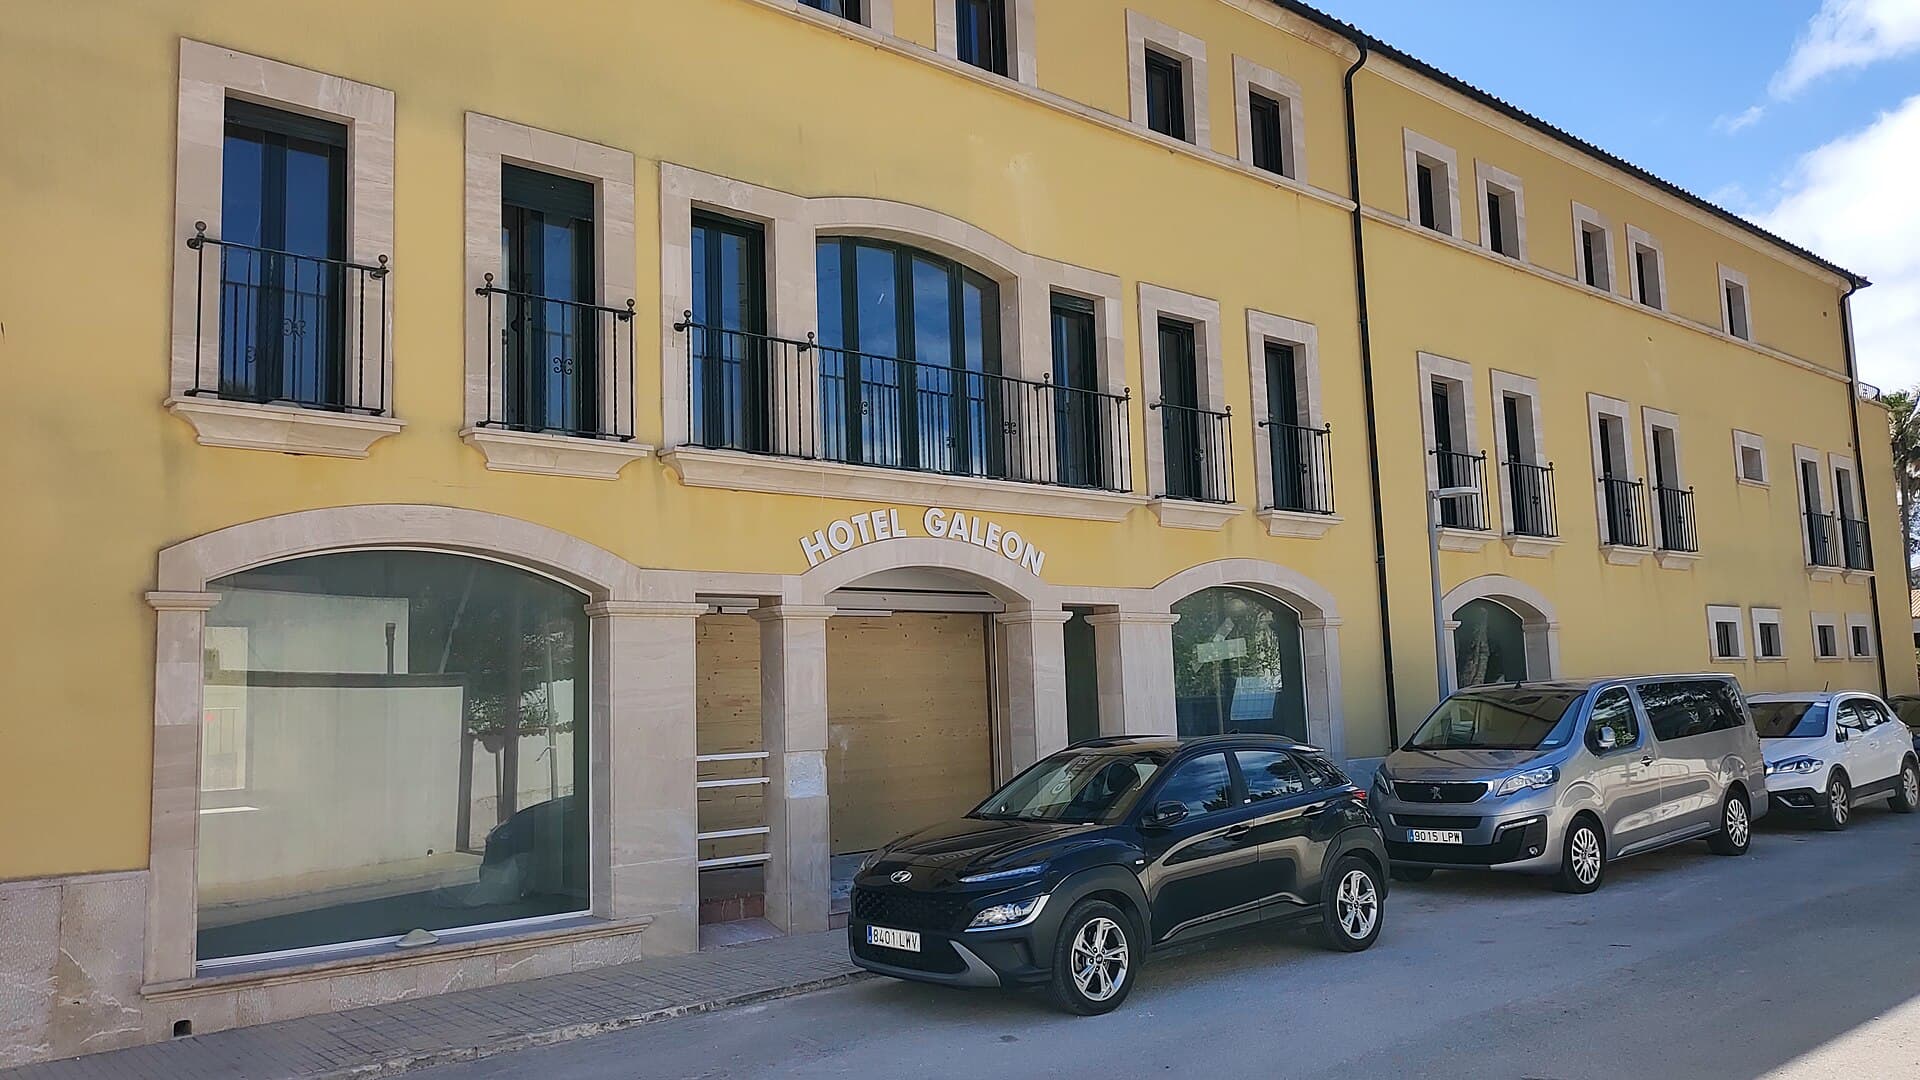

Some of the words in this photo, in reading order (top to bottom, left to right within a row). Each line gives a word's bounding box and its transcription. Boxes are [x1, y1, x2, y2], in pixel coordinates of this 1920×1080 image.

[800, 508, 907, 567] HOTEL
[923, 507, 1046, 577] GALEON
[1414, 831, 1438, 842] 9015
[1442, 831, 1460, 843] LPW
[873, 928, 896, 946] 8401
